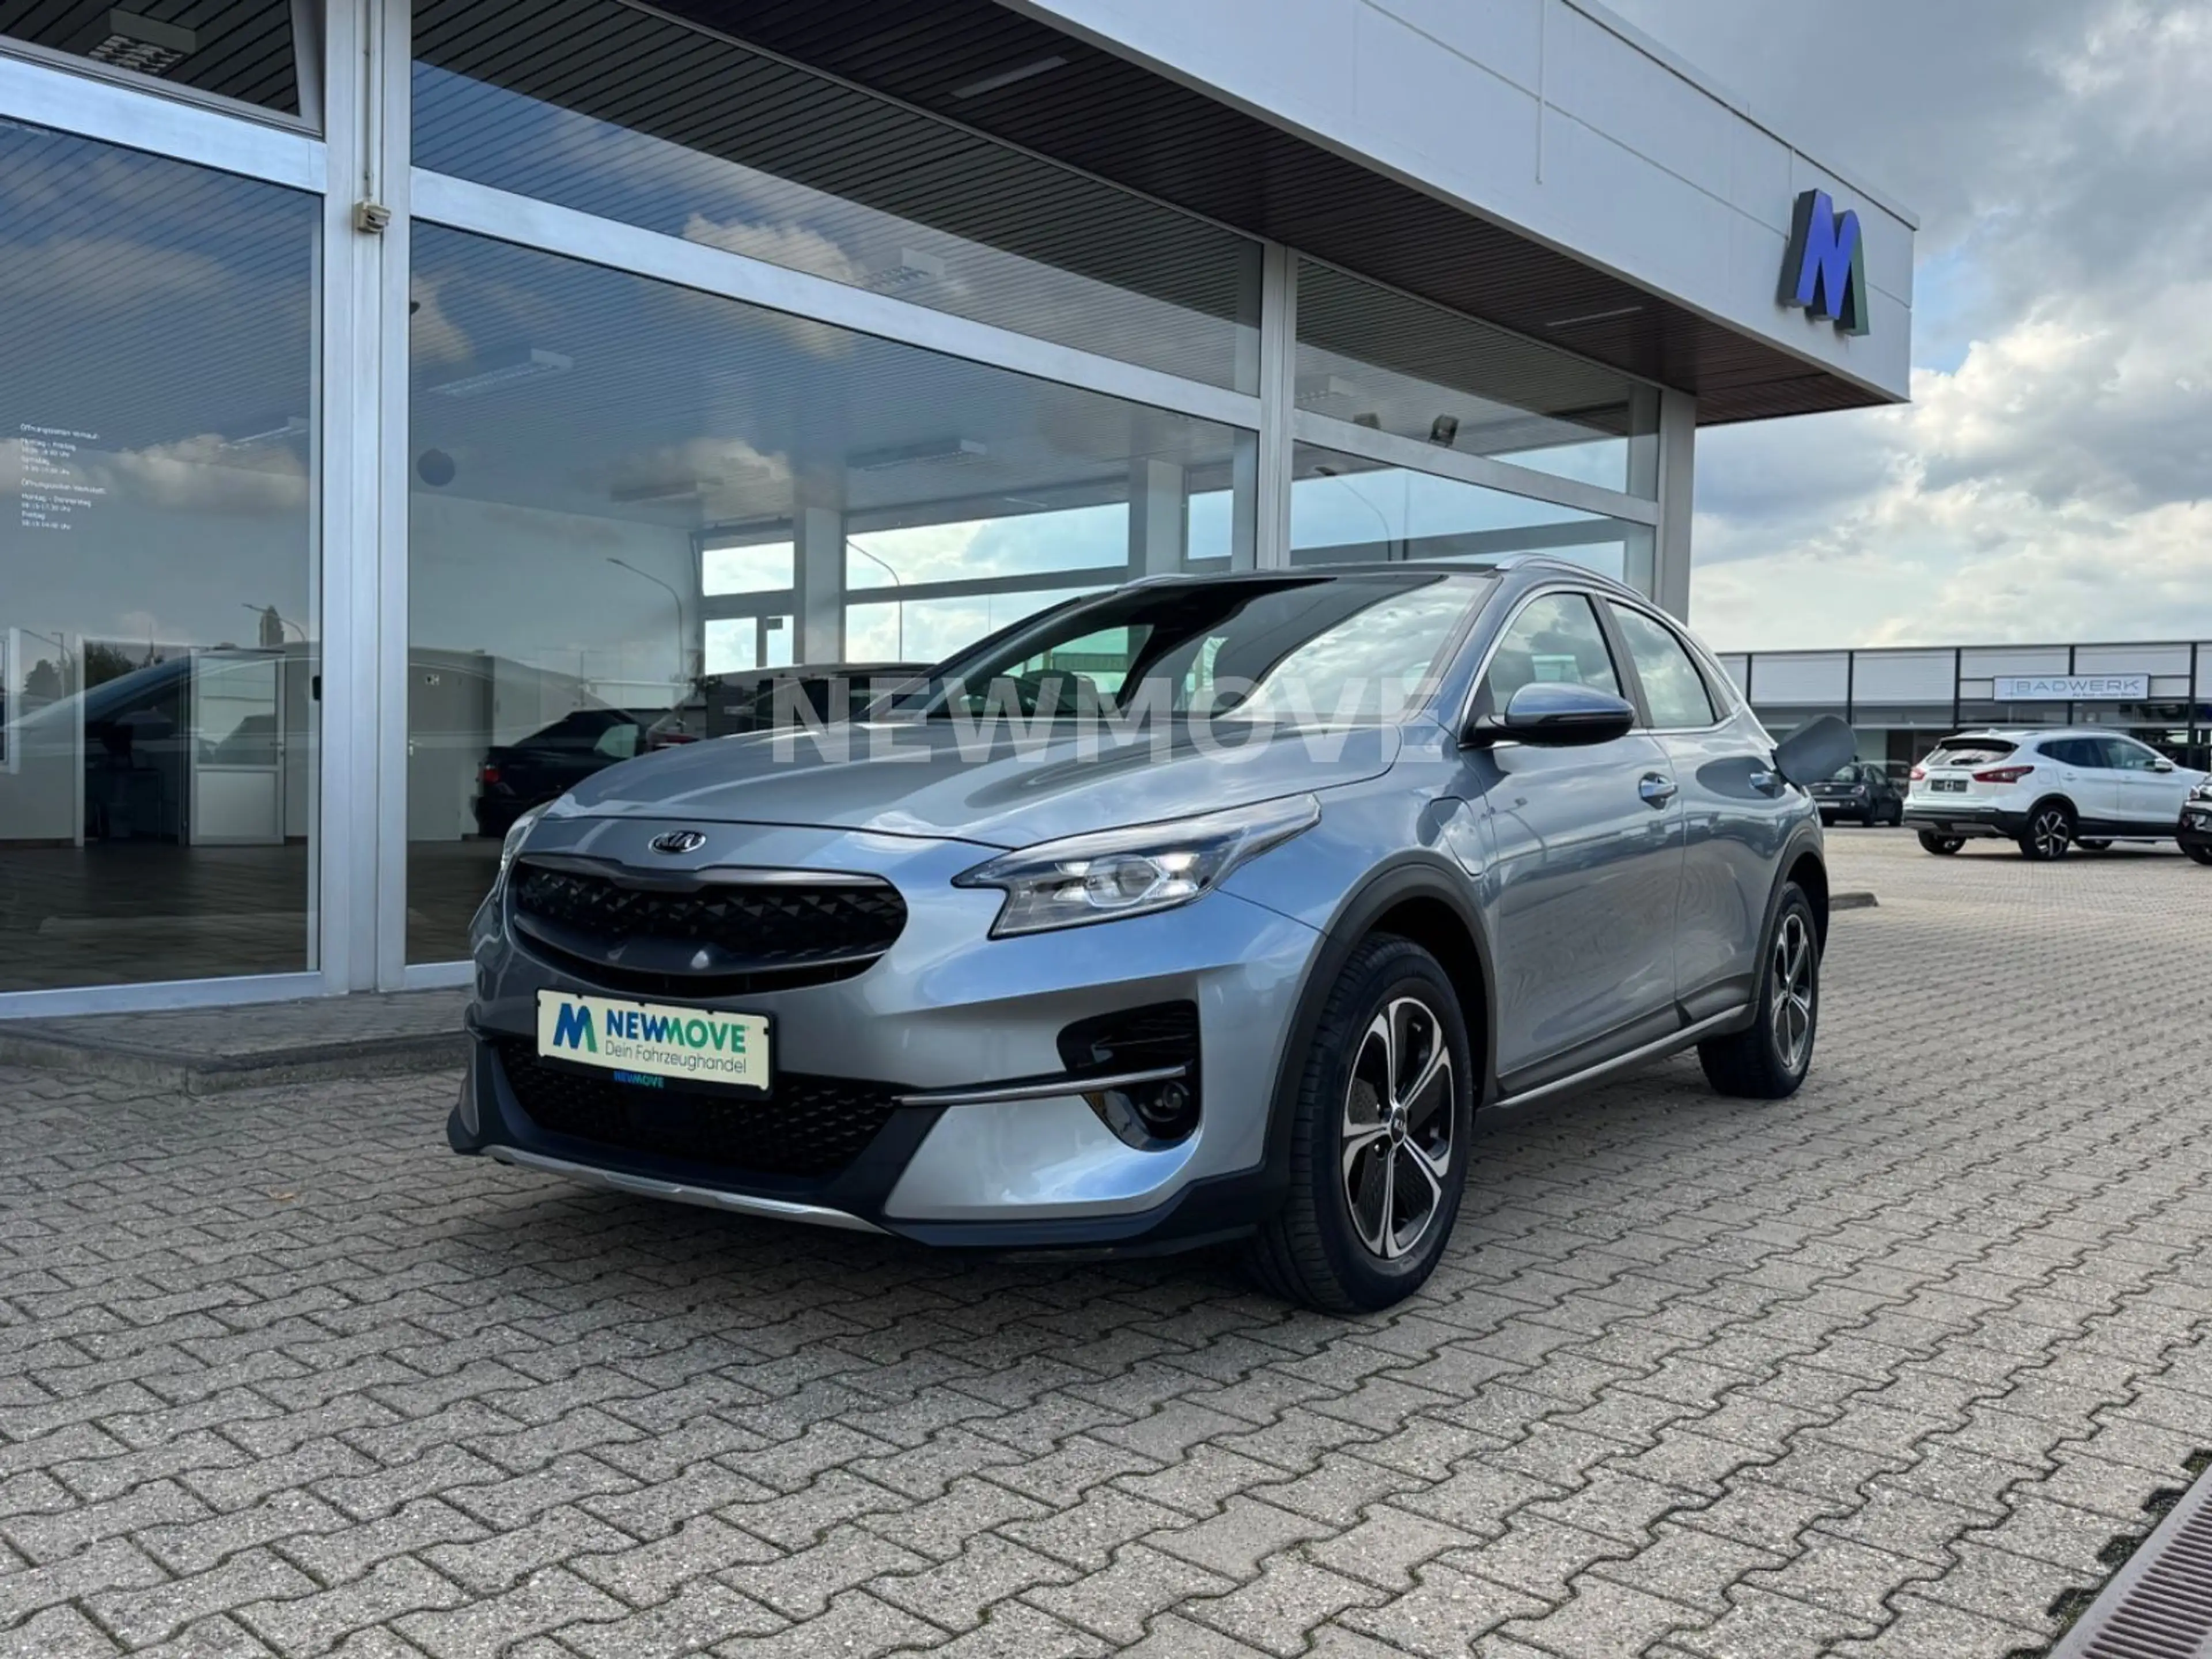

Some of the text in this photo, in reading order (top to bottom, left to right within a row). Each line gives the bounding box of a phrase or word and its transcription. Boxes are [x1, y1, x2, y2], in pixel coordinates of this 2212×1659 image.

[2017, 680, 2139, 692] BADWERK
[607, 1008, 746, 1054] NEWMOVE
[605, 1040, 746, 1074] Dein Fahrzeughandel
[613, 1070, 664, 1089] NEWMOVE
